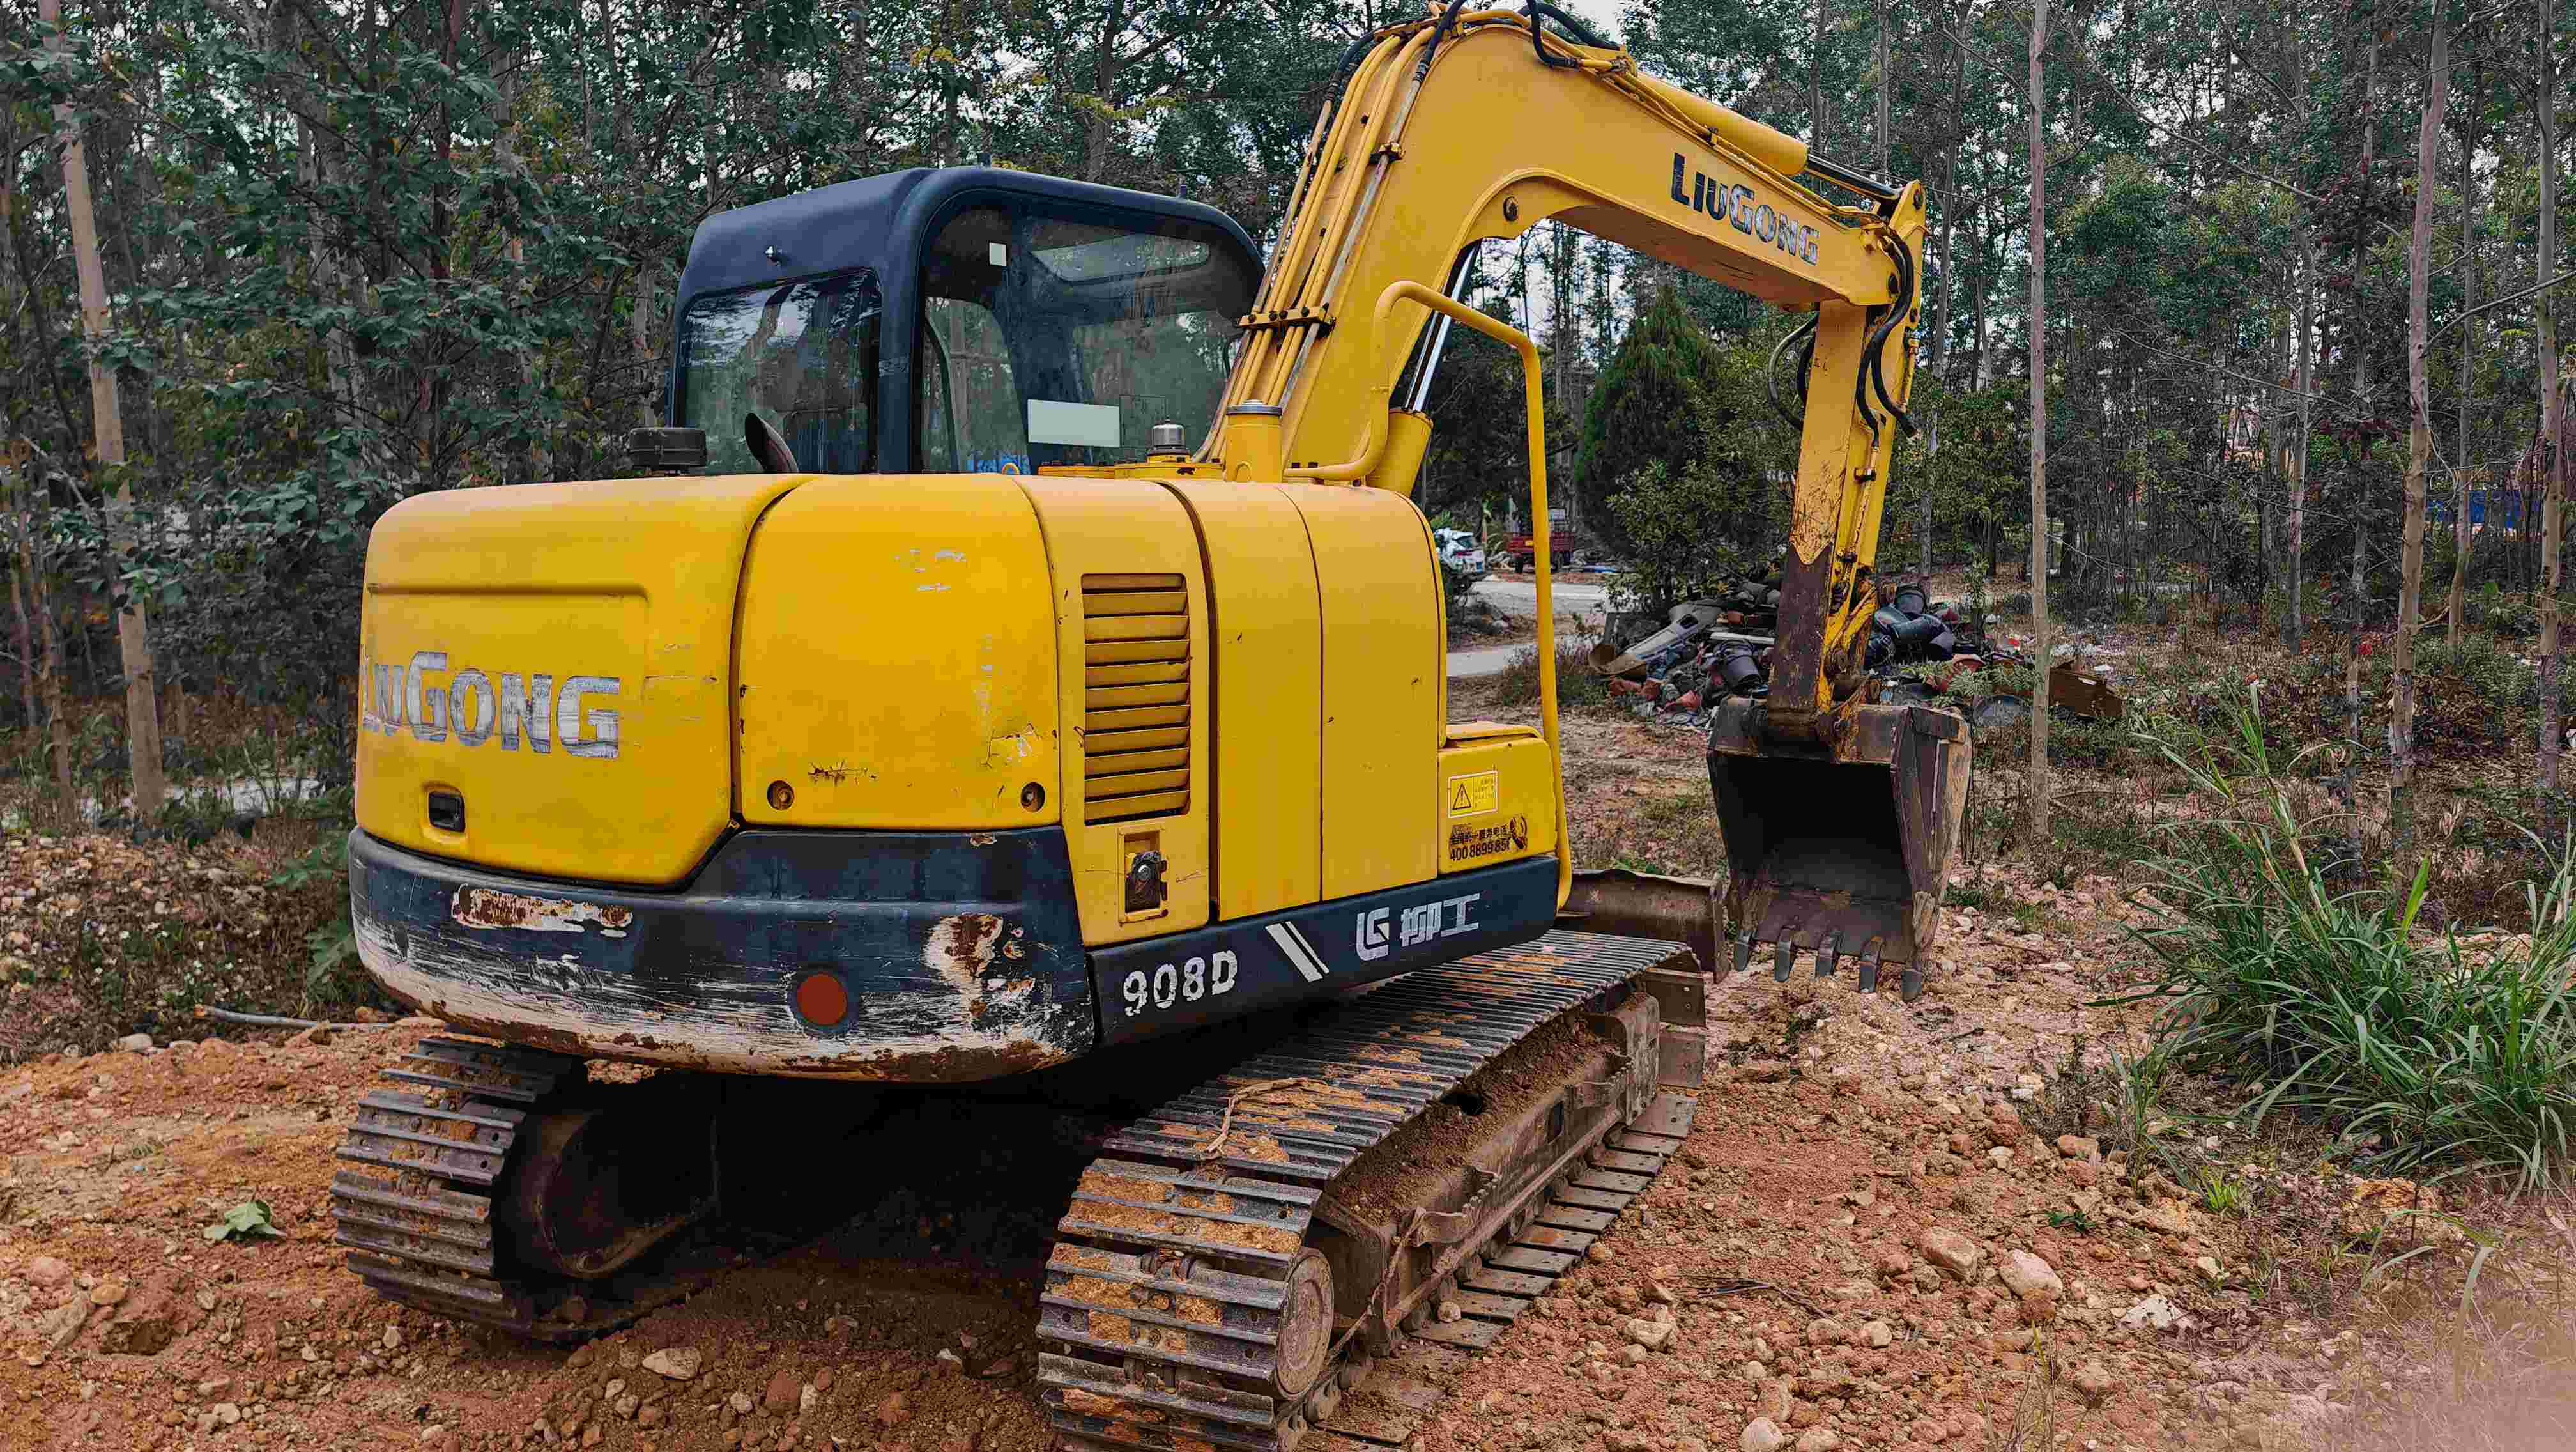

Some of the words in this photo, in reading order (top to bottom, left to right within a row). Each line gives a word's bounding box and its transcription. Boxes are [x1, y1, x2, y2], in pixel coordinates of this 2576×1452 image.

[1671, 152, 1820, 266] LIUGONG
[1400, 893, 1480, 947] 柳工
[1123, 950, 1238, 1017] 908D
